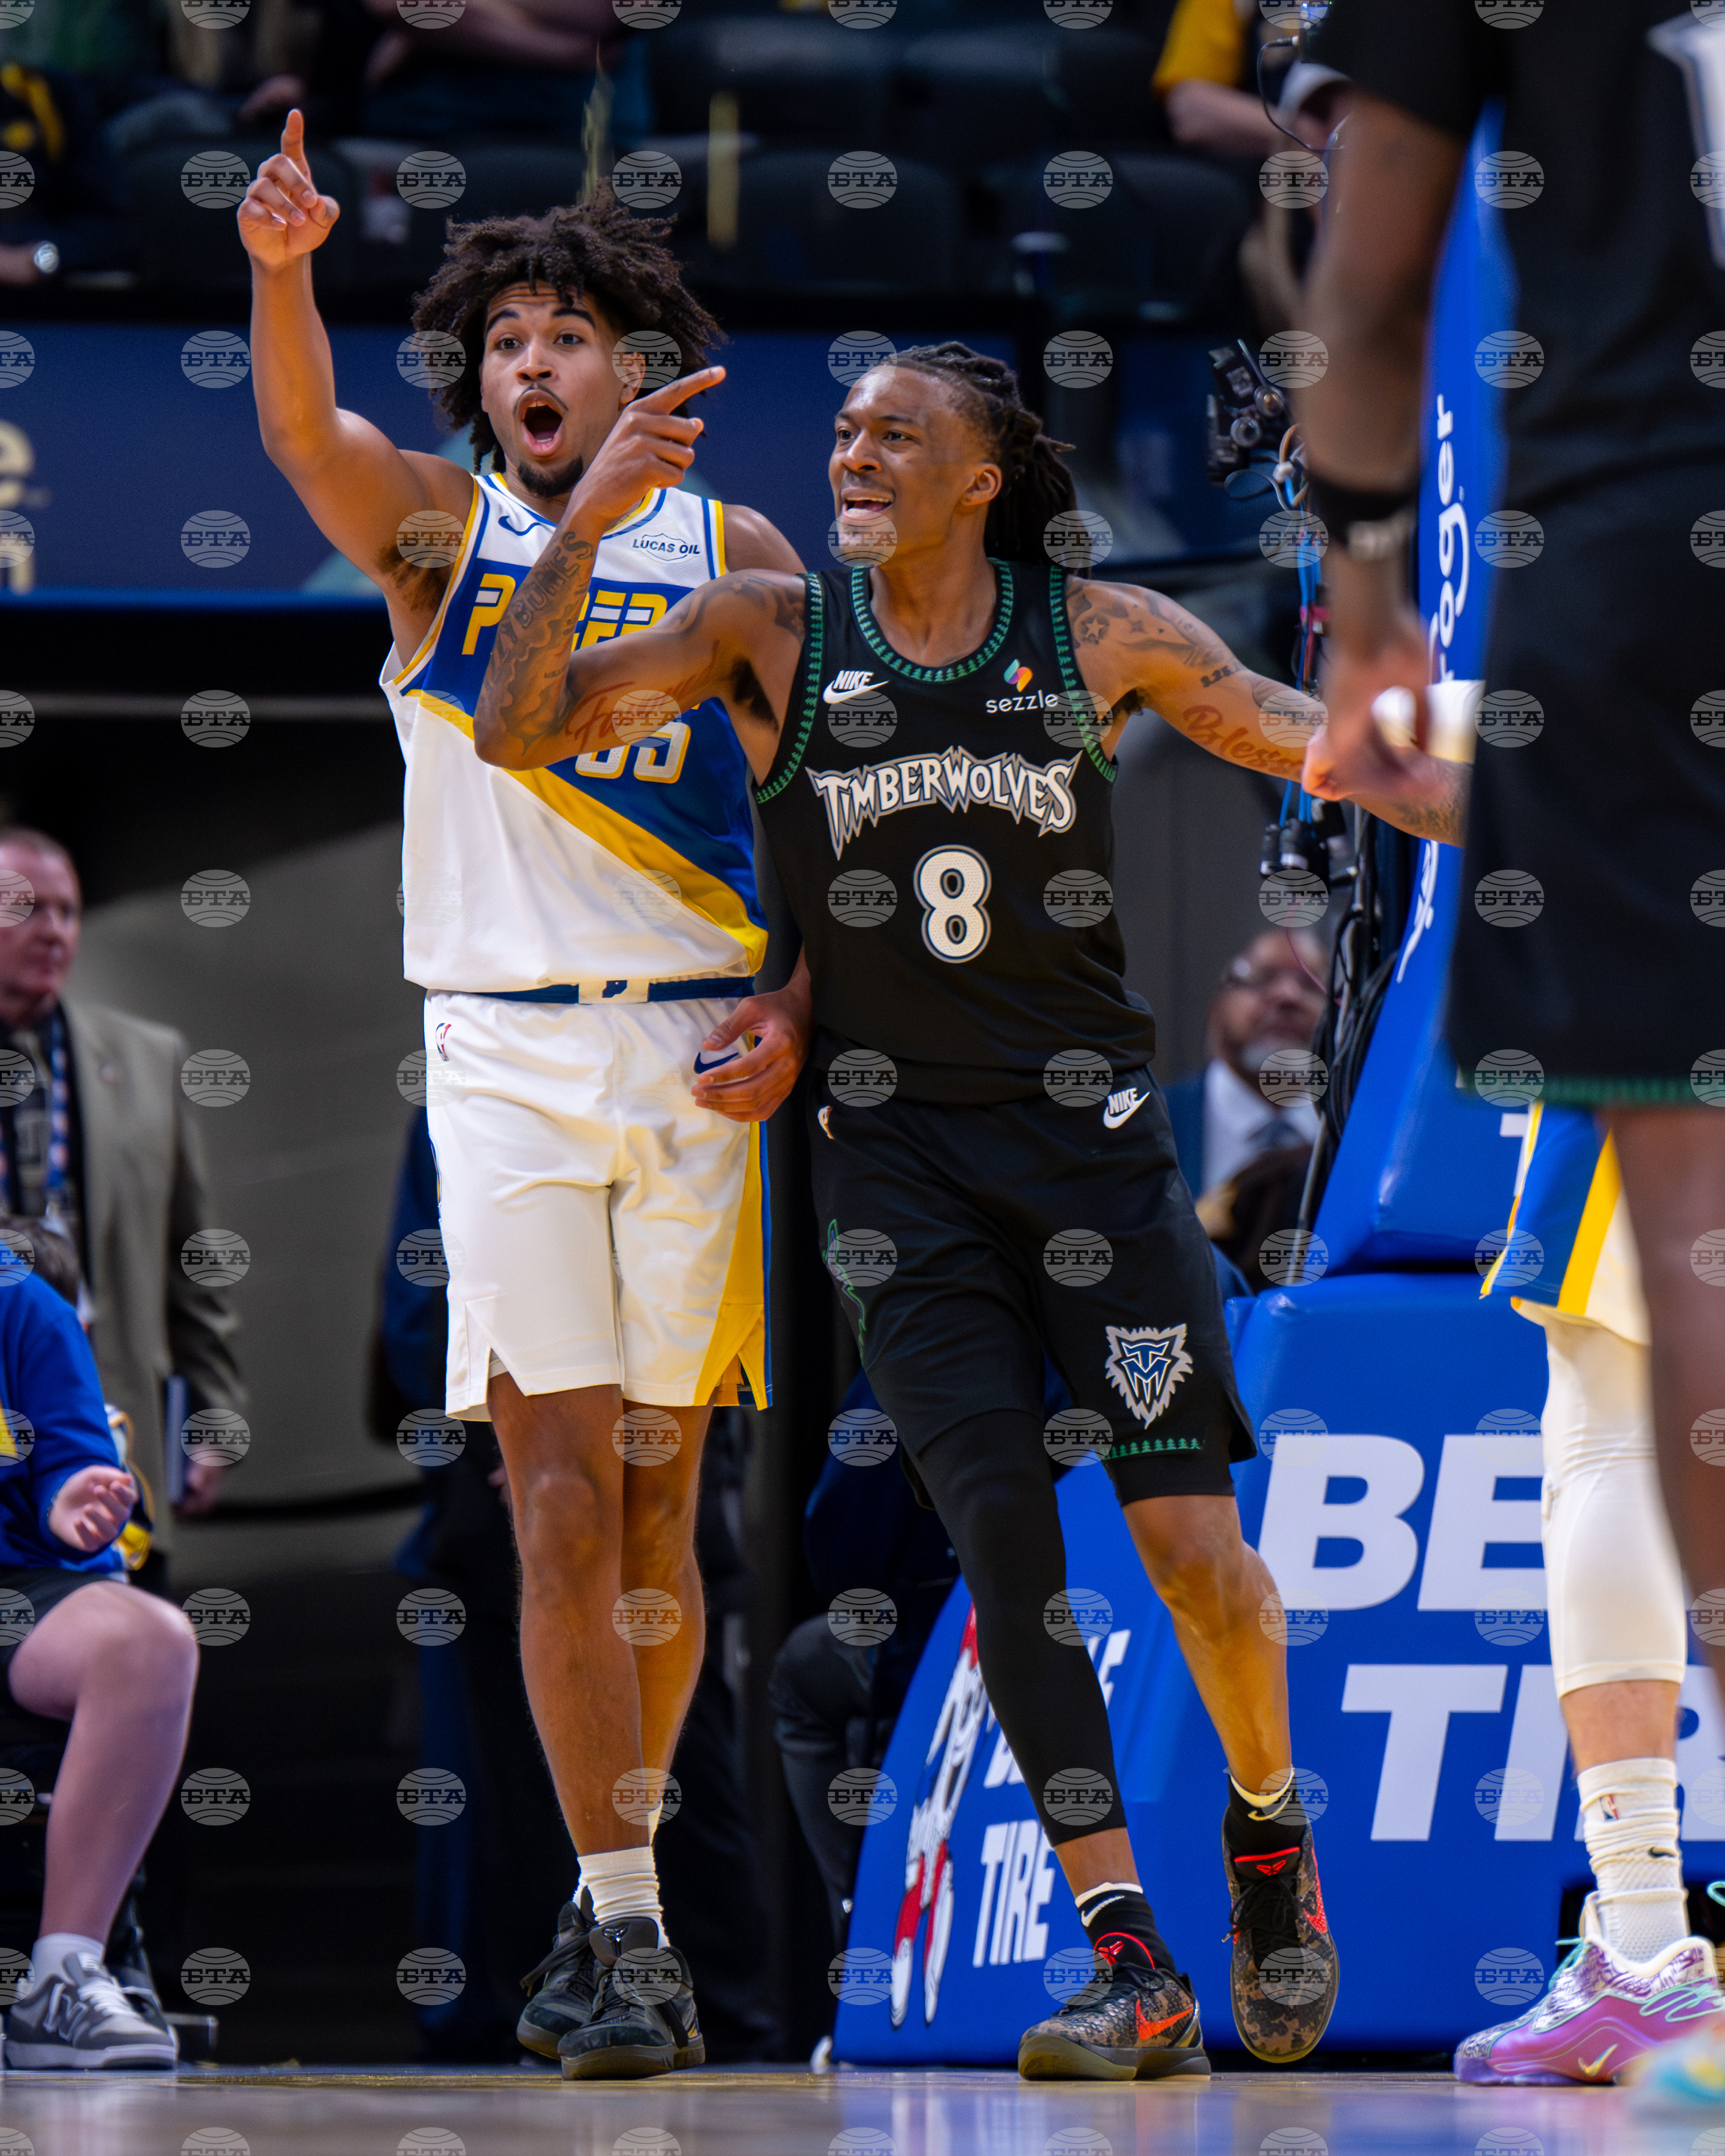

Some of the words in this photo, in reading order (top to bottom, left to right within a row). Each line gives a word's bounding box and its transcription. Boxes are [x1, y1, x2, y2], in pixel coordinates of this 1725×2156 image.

[632, 538, 676, 553] LUCAS
[679, 544, 701, 555] OIL
[1429, 393, 1471, 683] roger
[833, 670, 874, 691] NIKE
[985, 689, 1059, 713] sezzle
[805, 745, 1084, 861] TIMBERWOLVES
[913, 844, 992, 964] 8
[1107, 1086, 1138, 1115] NIKE
[972, 1819, 1055, 1967] TIRE
